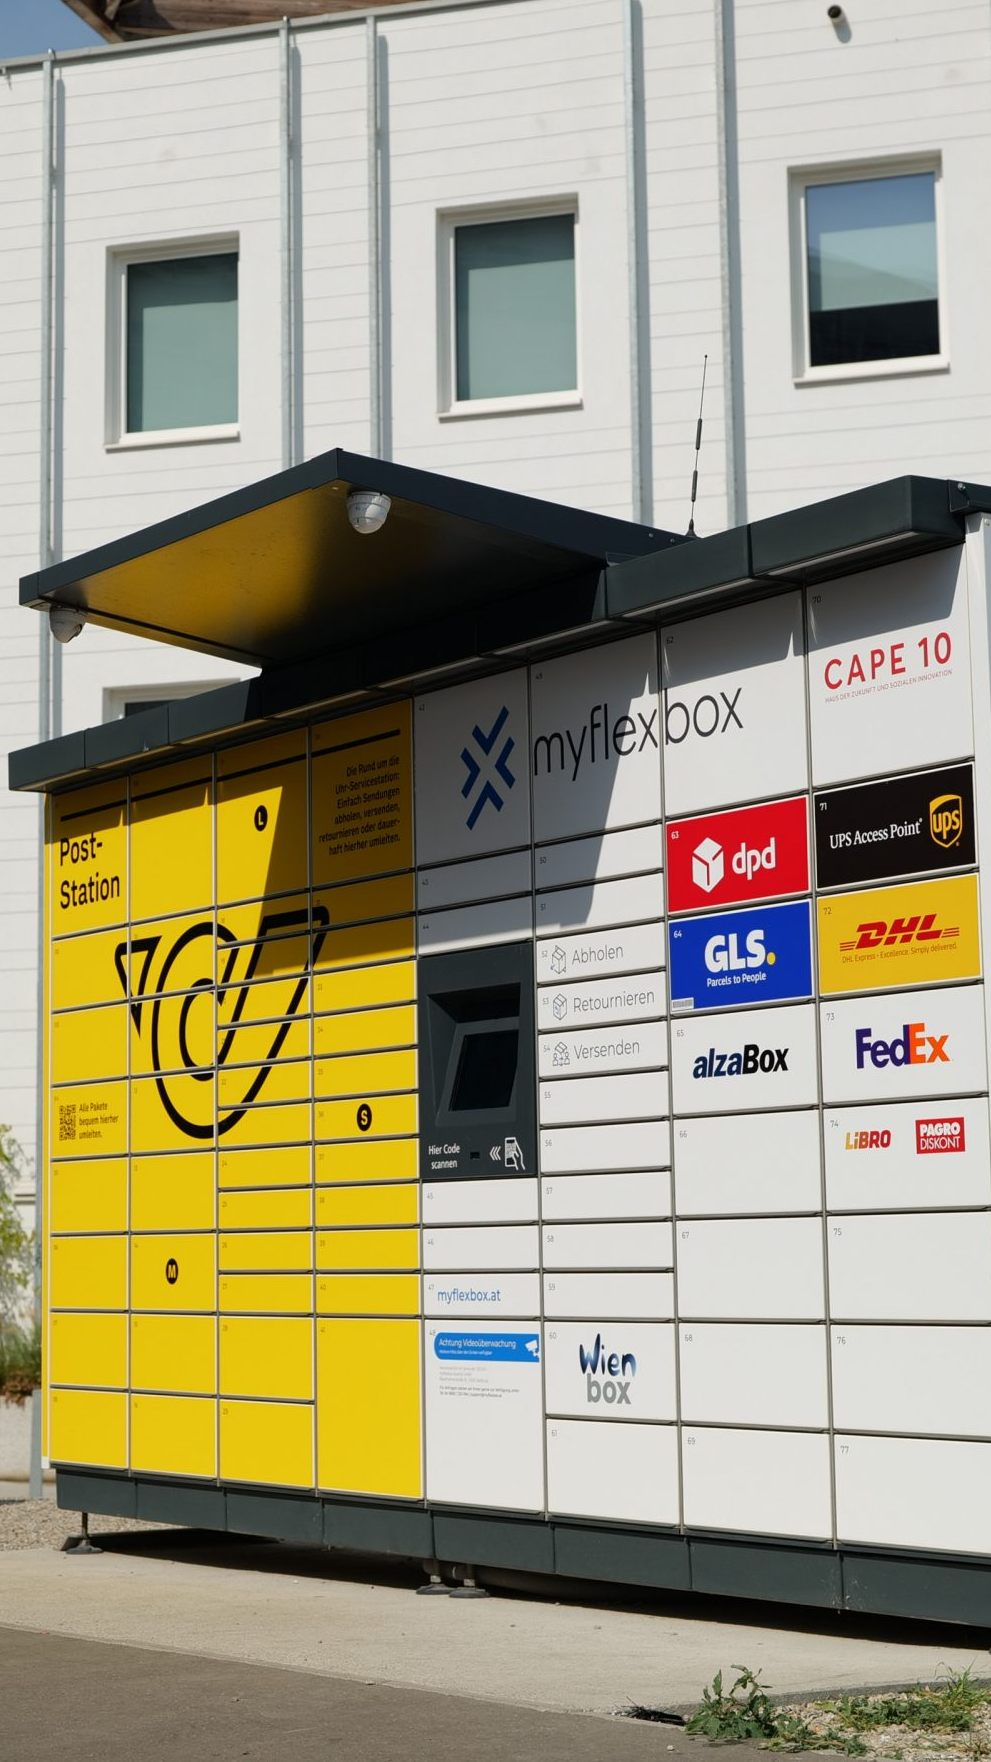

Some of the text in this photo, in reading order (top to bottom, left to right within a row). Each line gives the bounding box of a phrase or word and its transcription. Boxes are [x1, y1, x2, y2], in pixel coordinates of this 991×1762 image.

[824, 632, 952, 690] CAPE 10
[534, 687, 744, 781] myflexbox
[359, 762, 376, 774] Rund
[377, 760, 388, 769] um
[337, 787, 400, 809] Einfach Sendungen
[258, 811, 264, 826] L
[361, 821, 376, 834] oder
[932, 810, 960, 839] ups
[60, 832, 103, 866] Post-
[829, 831, 852, 849] UPS
[853, 828, 889, 845] Access
[732, 836, 776, 881] dpd
[60, 872, 120, 910] Station
[856, 913, 943, 949] DHL
[572, 945, 624, 965] Abholen
[707, 971, 767, 987] Parcels to People
[573, 991, 655, 1012] Retournieren
[573, 1039, 640, 1060] Versenden
[855, 1023, 951, 1069] FedEx
[693, 1044, 789, 1079] alzaBox
[361, 1110, 368, 1126] S
[919, 1122, 961, 1137] PAGRO
[428, 1143, 461, 1155] Hier Code
[920, 1136, 961, 1150] DISKONT
[431, 1160, 458, 1169] scannen
[168, 1264, 177, 1279] M
[437, 1288, 502, 1304] myflexbox.at
[438, 1338, 517, 1350] Achtung Videoüberwachung
[579, 1333, 637, 1377] Wien
[587, 1373, 632, 1405] box
